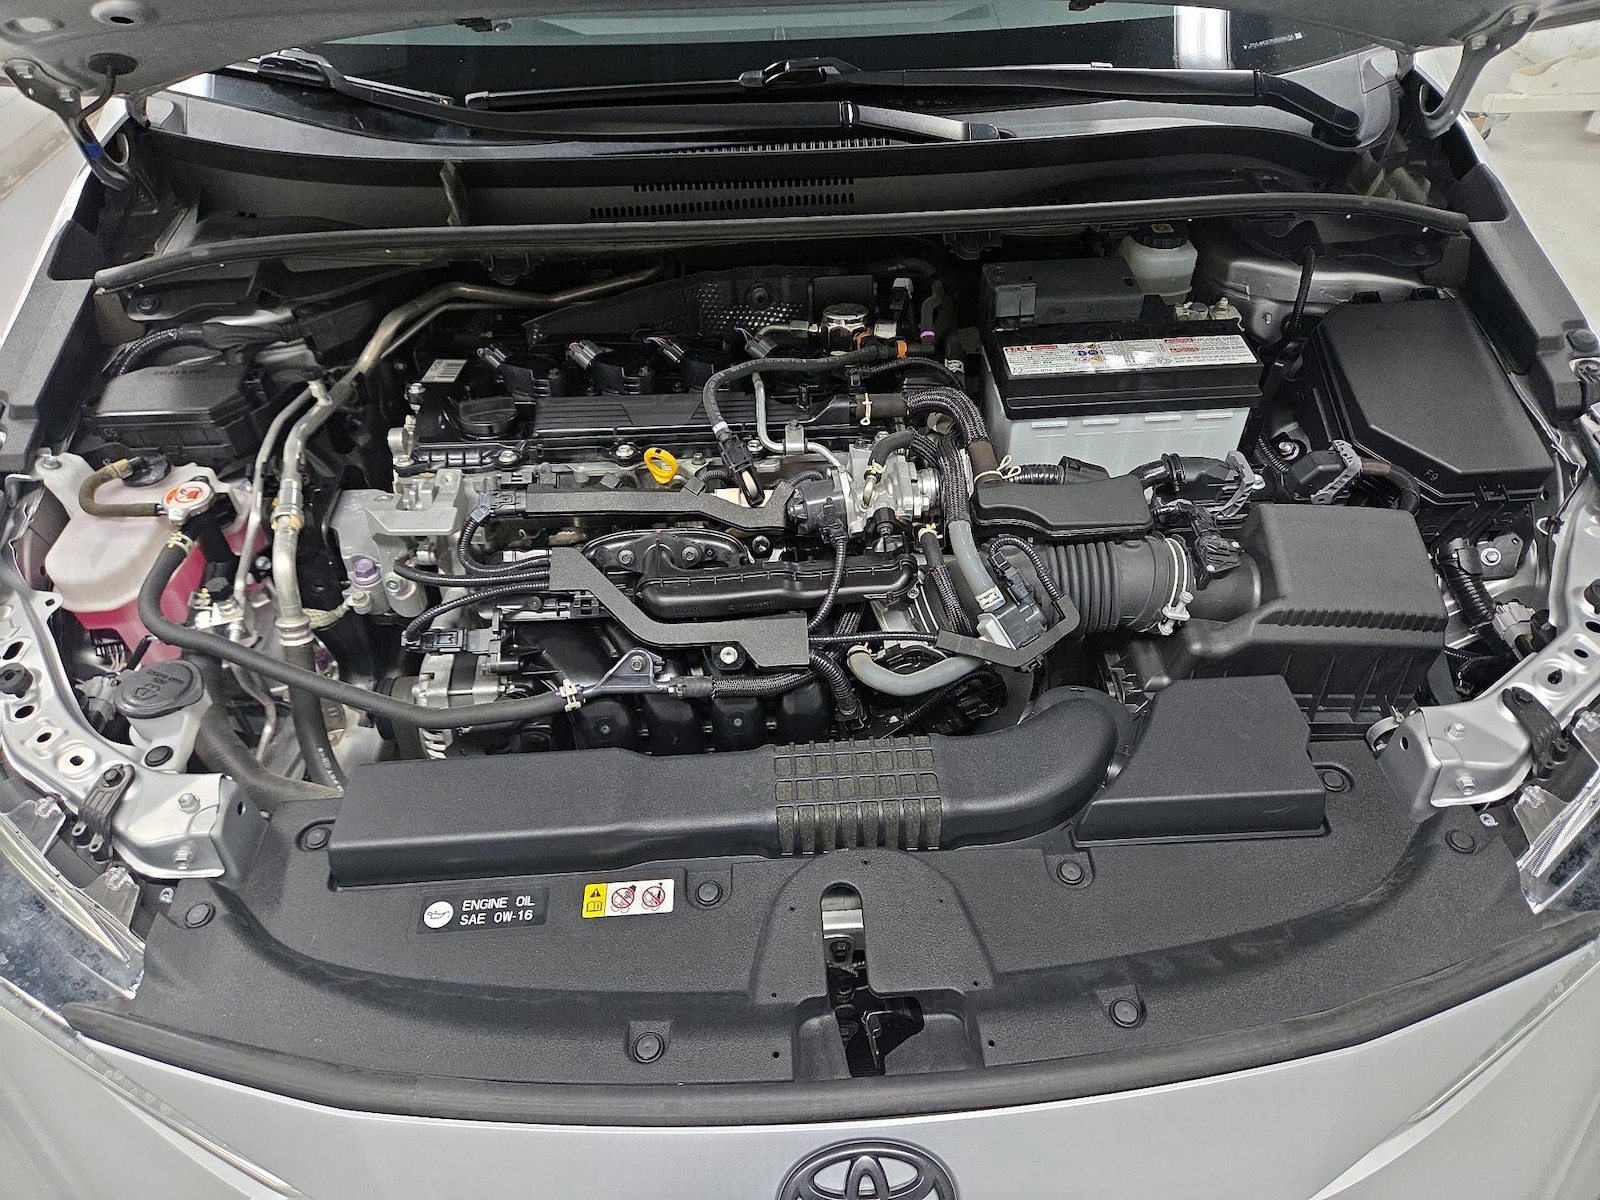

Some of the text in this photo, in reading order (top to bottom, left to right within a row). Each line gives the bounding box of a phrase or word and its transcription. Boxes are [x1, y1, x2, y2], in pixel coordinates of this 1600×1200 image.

[1424, 469, 1439, 481] F9
[462, 895, 535, 911] ENGINE OIL
[460, 909, 533, 926] SAE 0W-16
